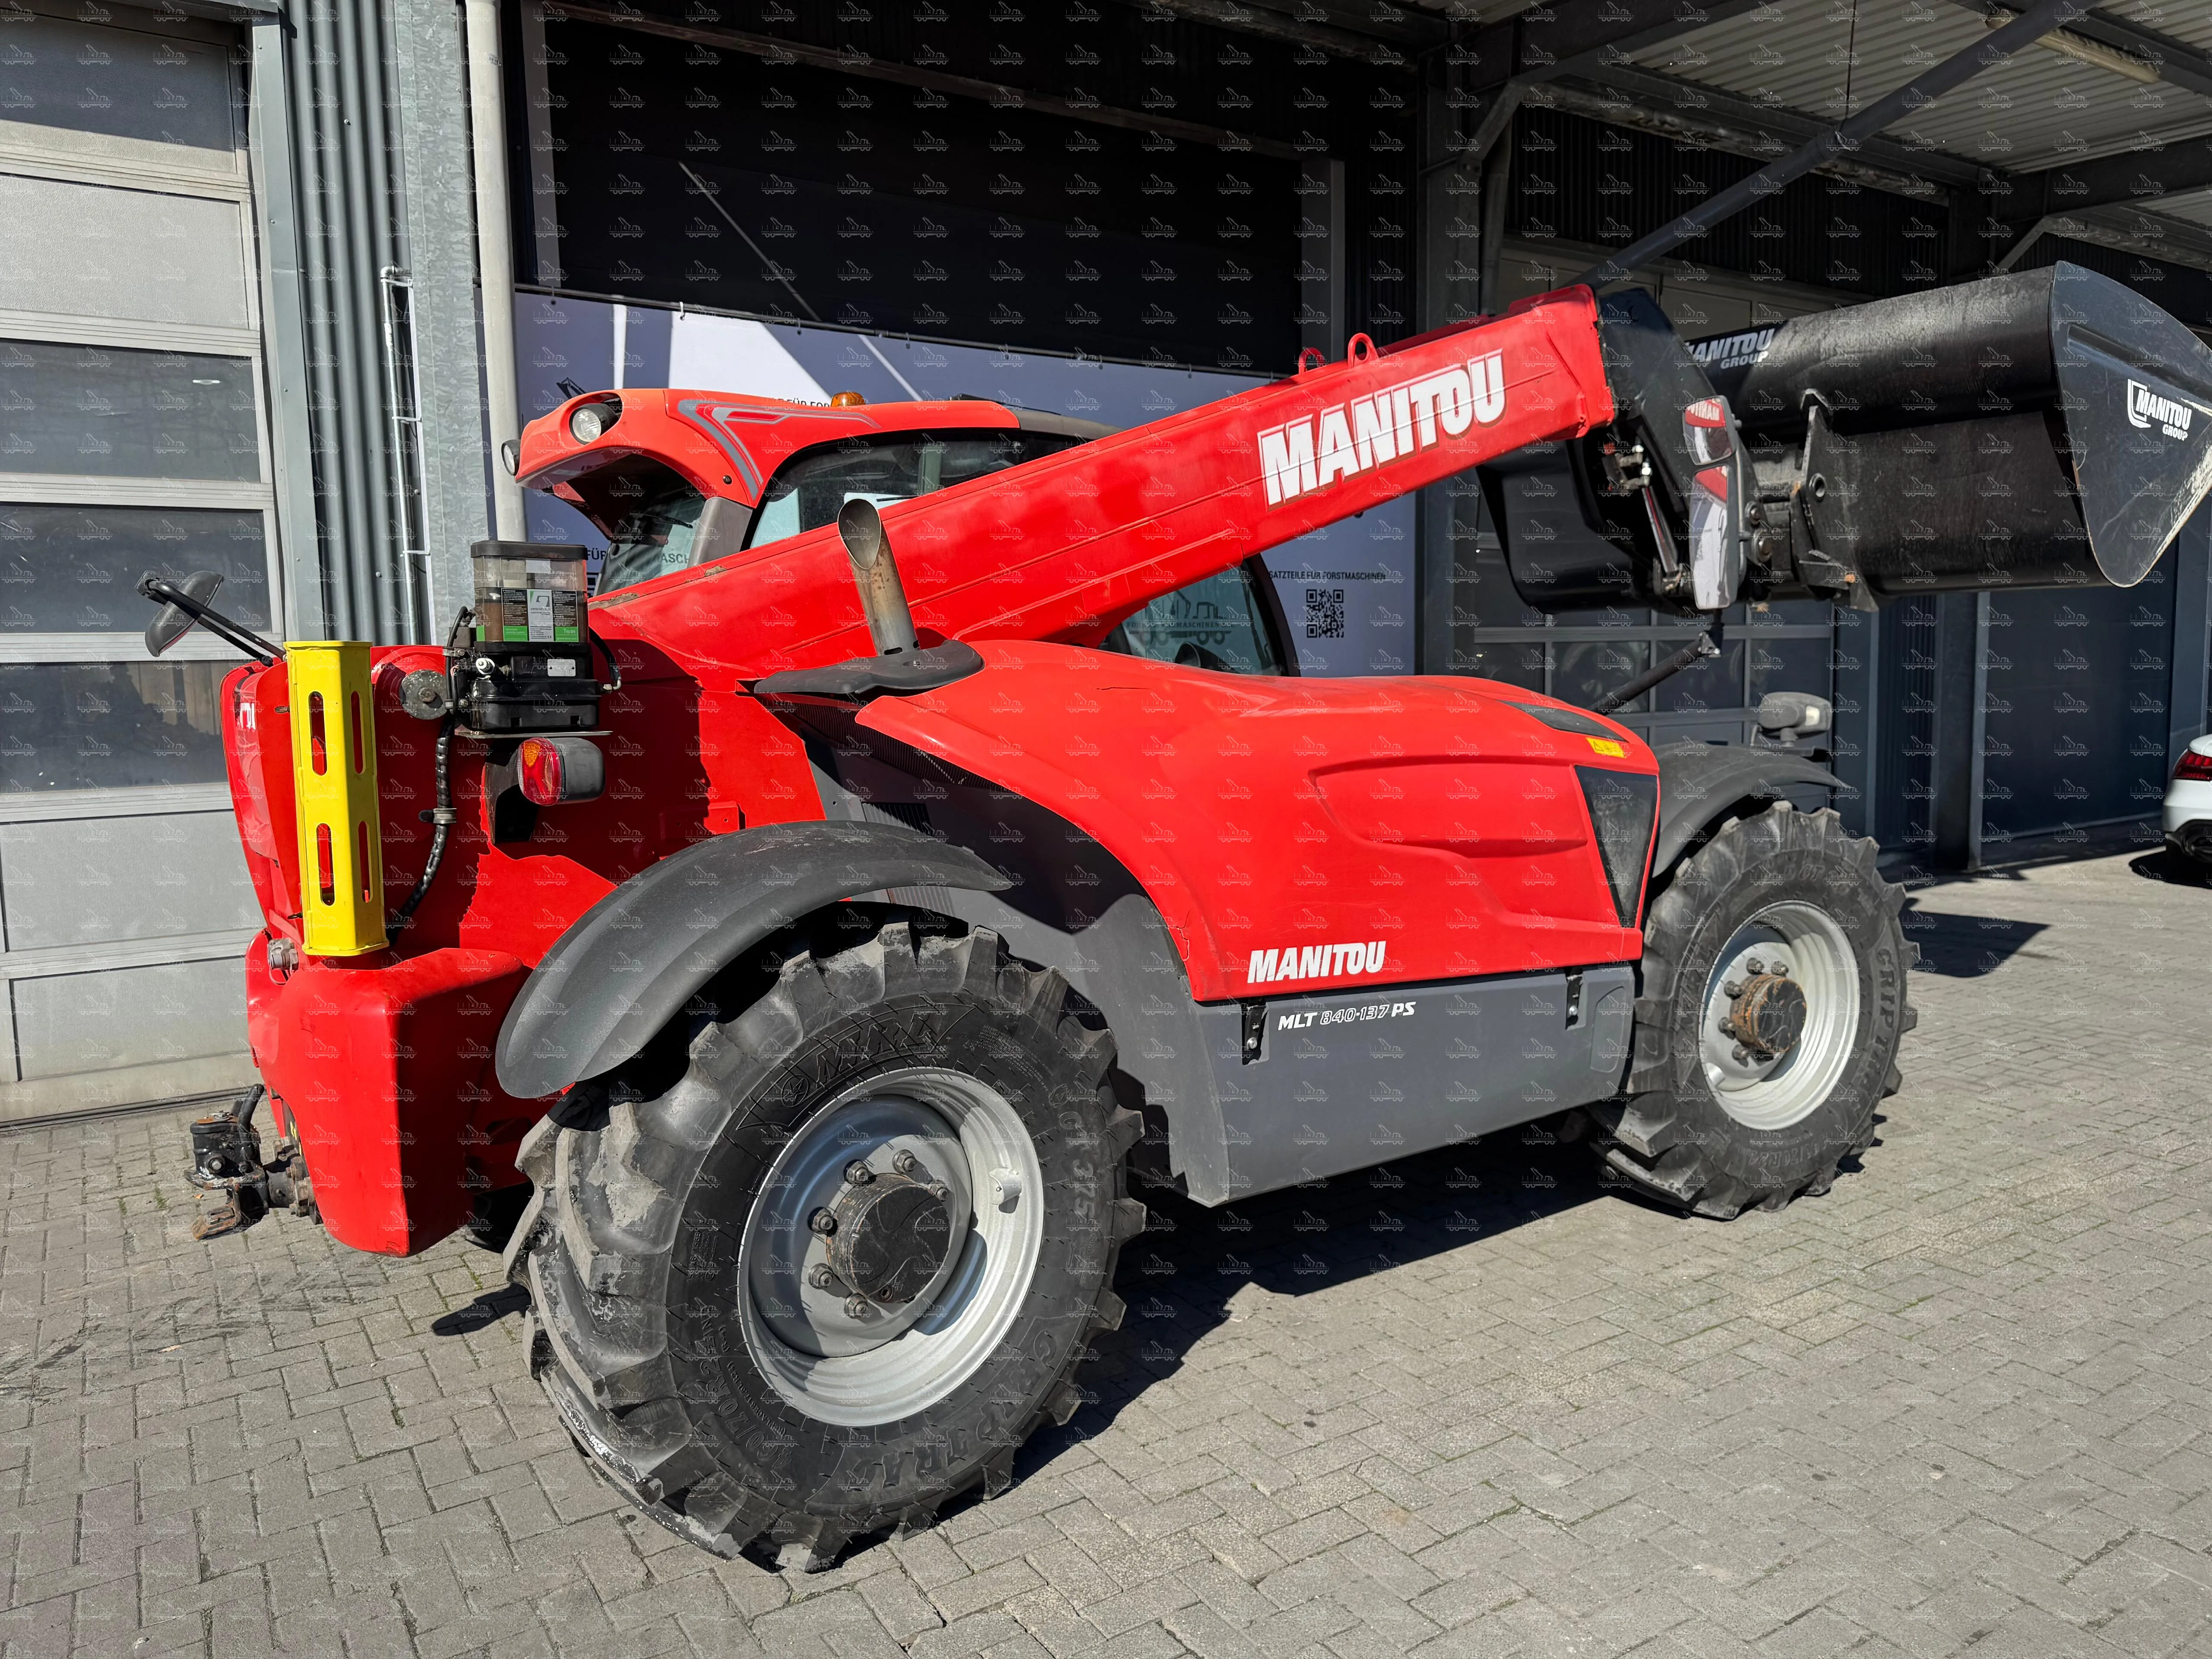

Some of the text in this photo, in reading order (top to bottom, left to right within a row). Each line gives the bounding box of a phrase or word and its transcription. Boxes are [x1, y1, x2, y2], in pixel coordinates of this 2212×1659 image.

[1720, 351, 1769, 369] GROUP
[2136, 389, 2192, 430] MANITOU
[1257, 349, 1506, 512] MANITOU
[1247, 941, 1386, 983] MANITOU
[1876, 948, 1895, 1028] GRIP
[1278, 1012, 1317, 1030] MLT
[1391, 1001, 1416, 1017] PS
